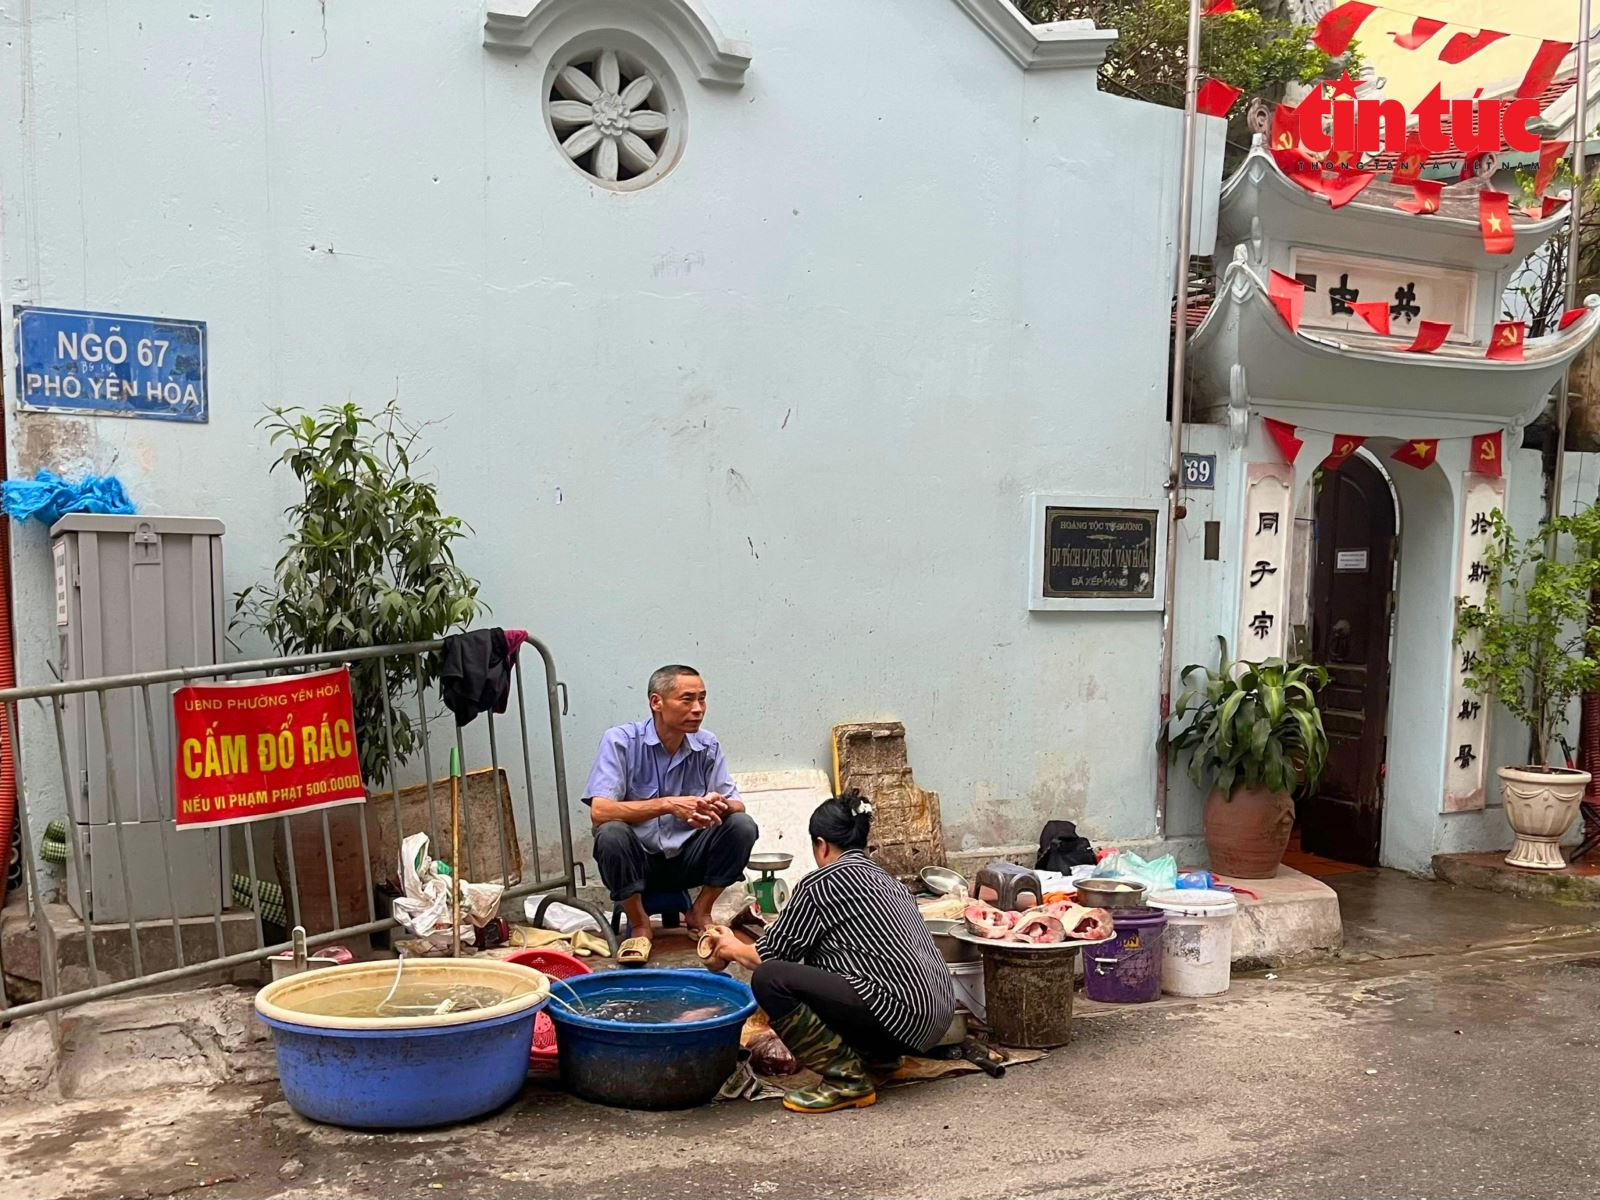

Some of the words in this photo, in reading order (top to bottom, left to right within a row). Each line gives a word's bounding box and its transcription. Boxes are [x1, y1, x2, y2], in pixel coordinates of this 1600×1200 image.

[57, 325, 128, 364] NGÕ
[136, 338, 170, 368] 67
[88, 372, 139, 401] YÊN
[145, 376, 200, 406] HÒA
[1186, 459, 1211, 483] 69
[184, 698, 223, 712] UBND
[227, 693, 288, 710] PHƯỜNG
[291, 688, 313, 704] YÊN
[183, 720, 249, 780] CẤM
[257, 713, 295, 772] ĐỔ
[302, 713, 352, 765] RÁC
[183, 792, 211, 814] NẾU
[214, 796, 226, 810] VI
[229, 790, 268, 808] PHẠM
[272, 785, 304, 803] PHẠT
